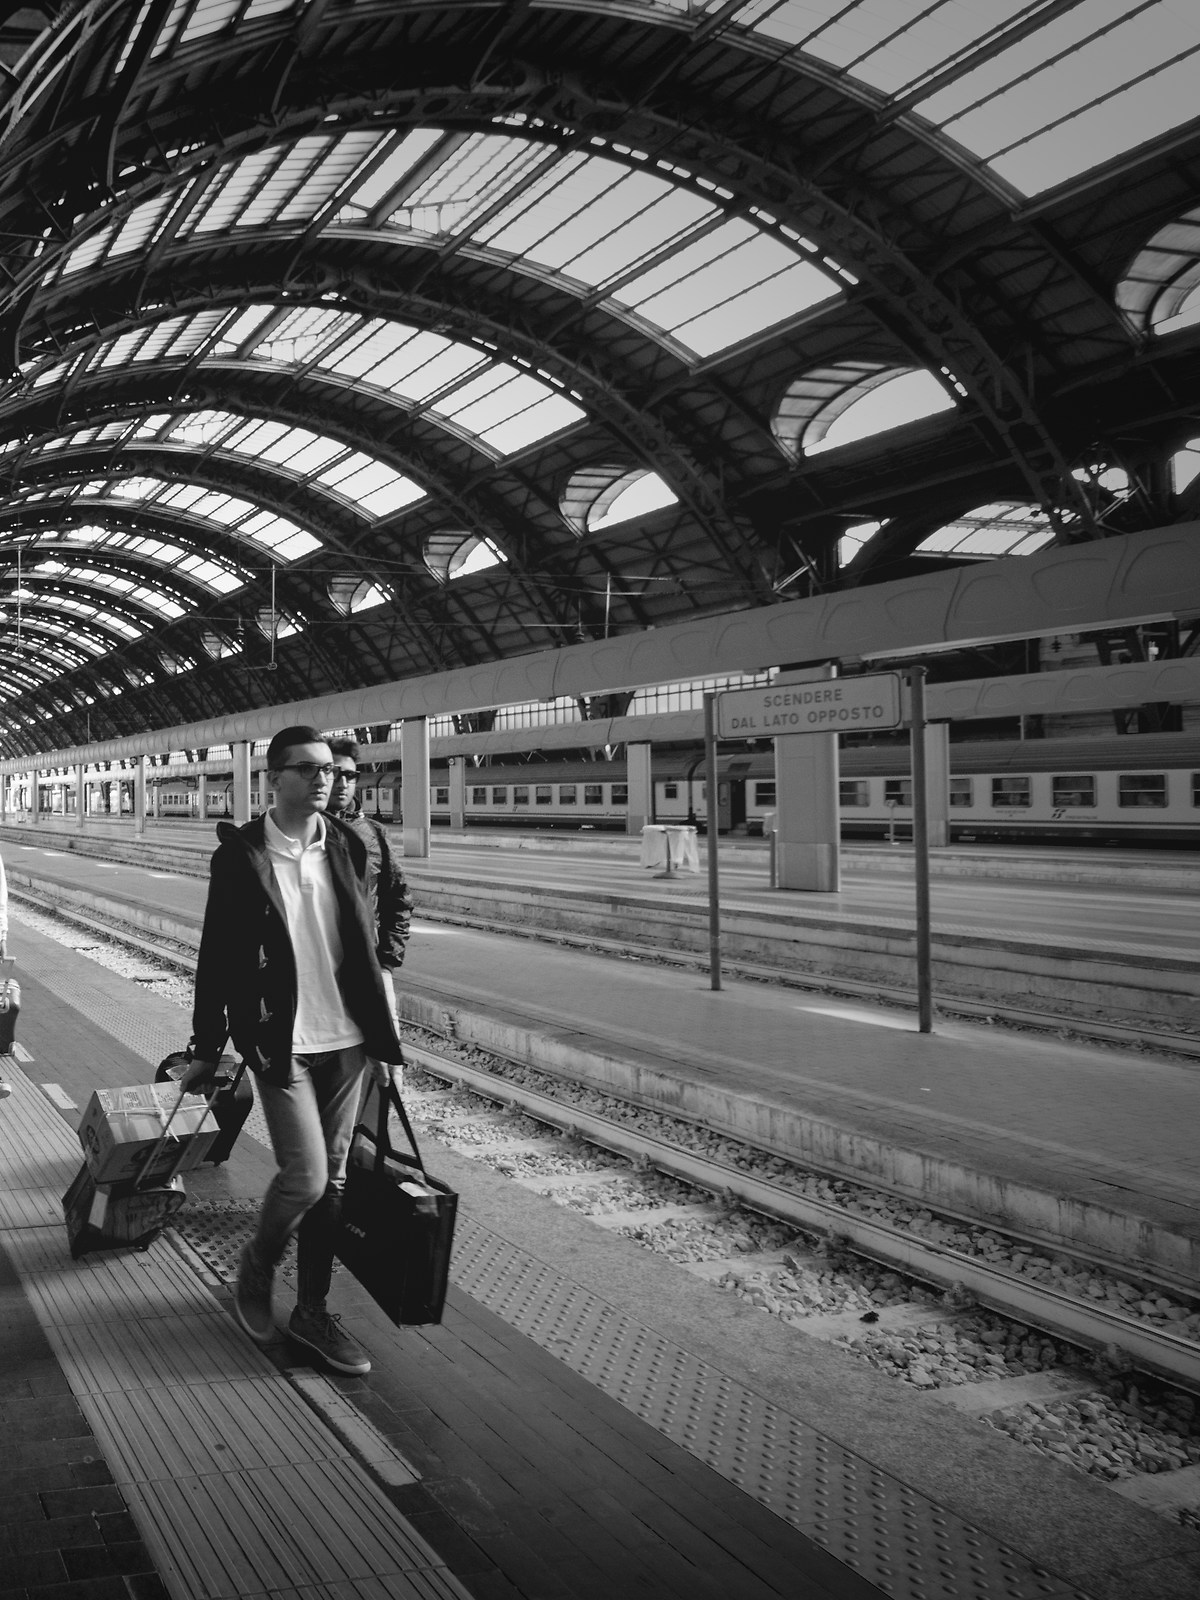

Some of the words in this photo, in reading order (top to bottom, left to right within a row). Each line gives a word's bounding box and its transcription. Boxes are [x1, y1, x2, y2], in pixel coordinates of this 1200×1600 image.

[763, 688, 843, 708] SCENDERE
[731, 717, 756, 729] DAL
[763, 713, 799, 728] LATO
[807, 705, 884, 723] OPPOSTO
